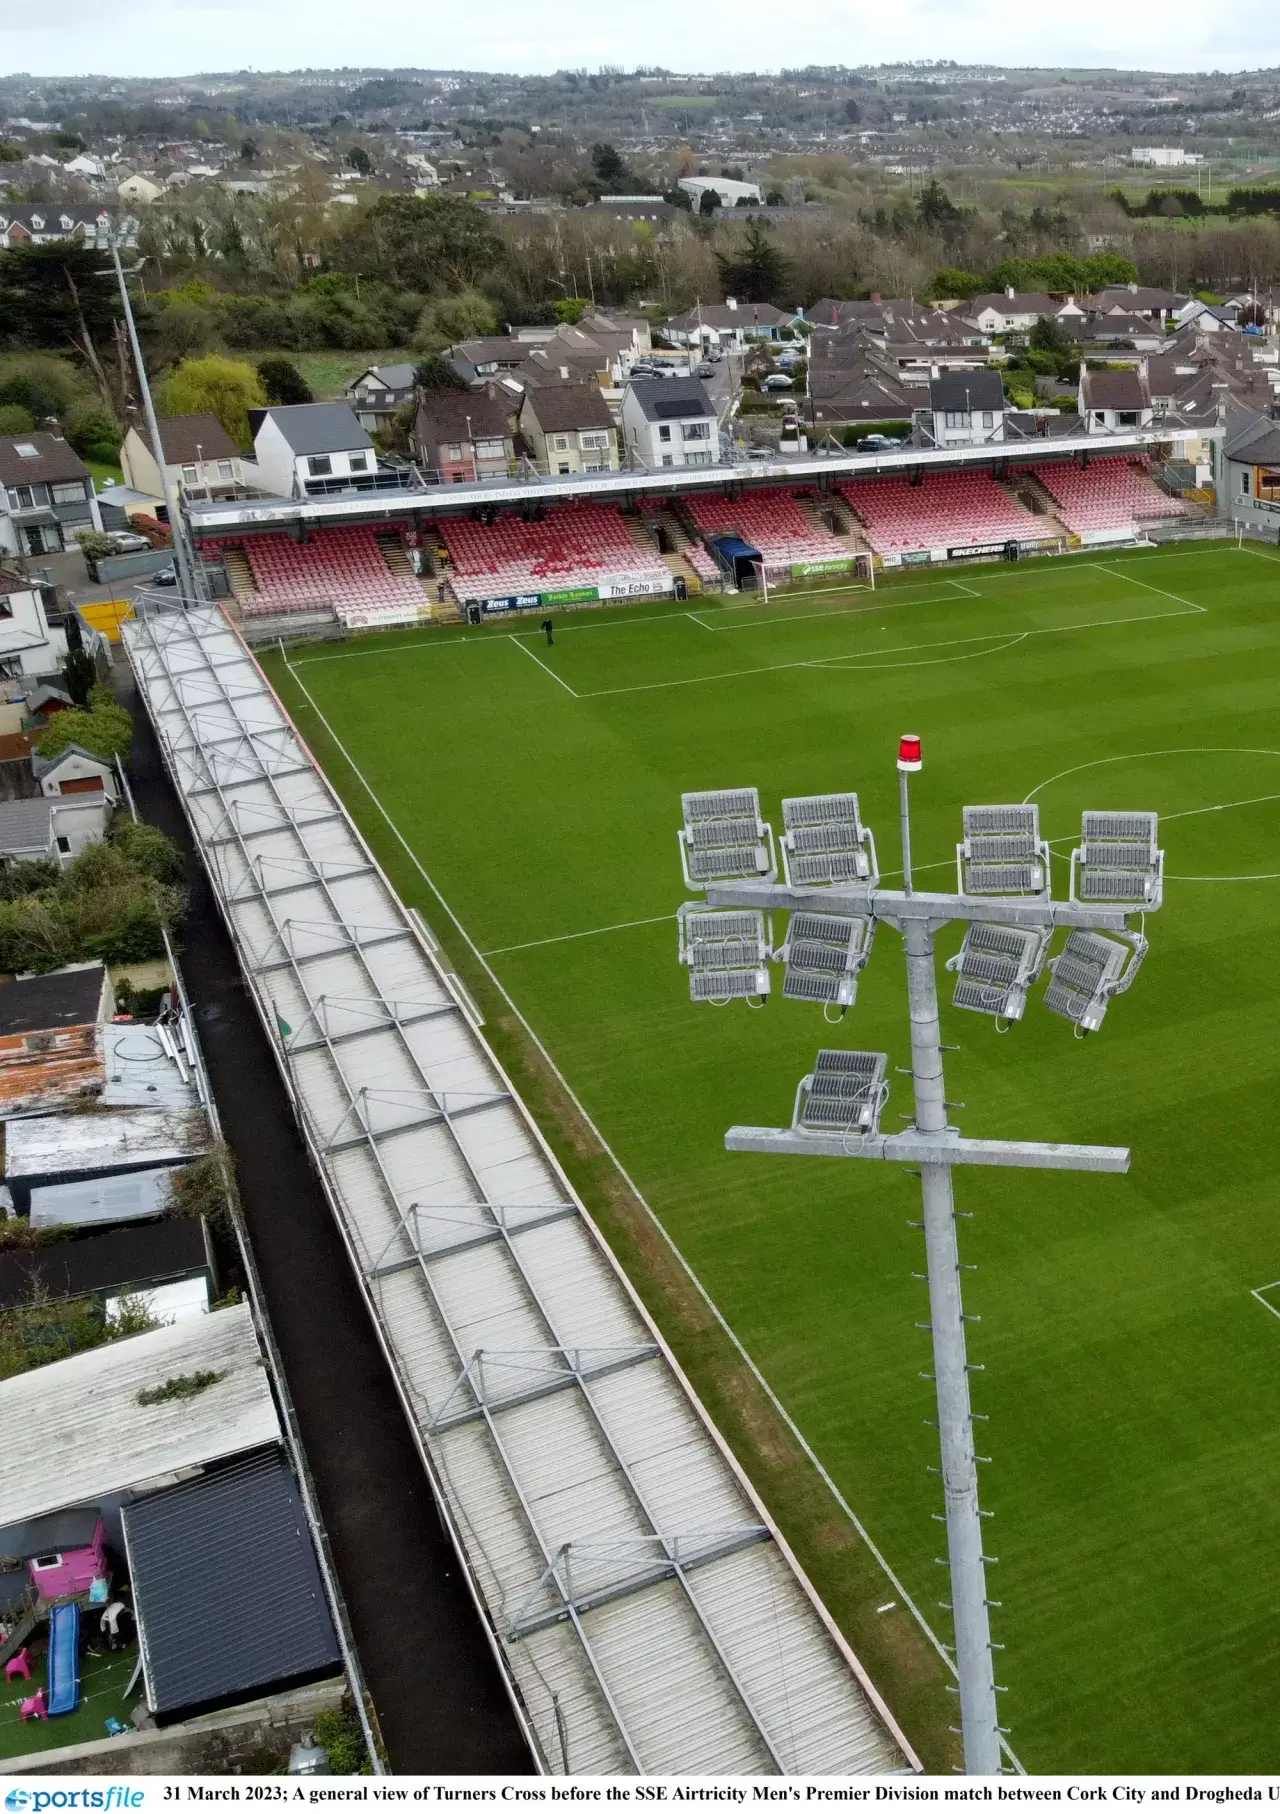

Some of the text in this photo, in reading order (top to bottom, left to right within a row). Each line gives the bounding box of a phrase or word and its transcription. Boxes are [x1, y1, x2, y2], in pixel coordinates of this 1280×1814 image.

[951, 544, 1005, 557] SKECHERS
[610, 585, 626, 596] The
[628, 583, 650, 593] Echo
[486, 599, 509, 608] Zeus
[516, 596, 538, 605] Zeus
